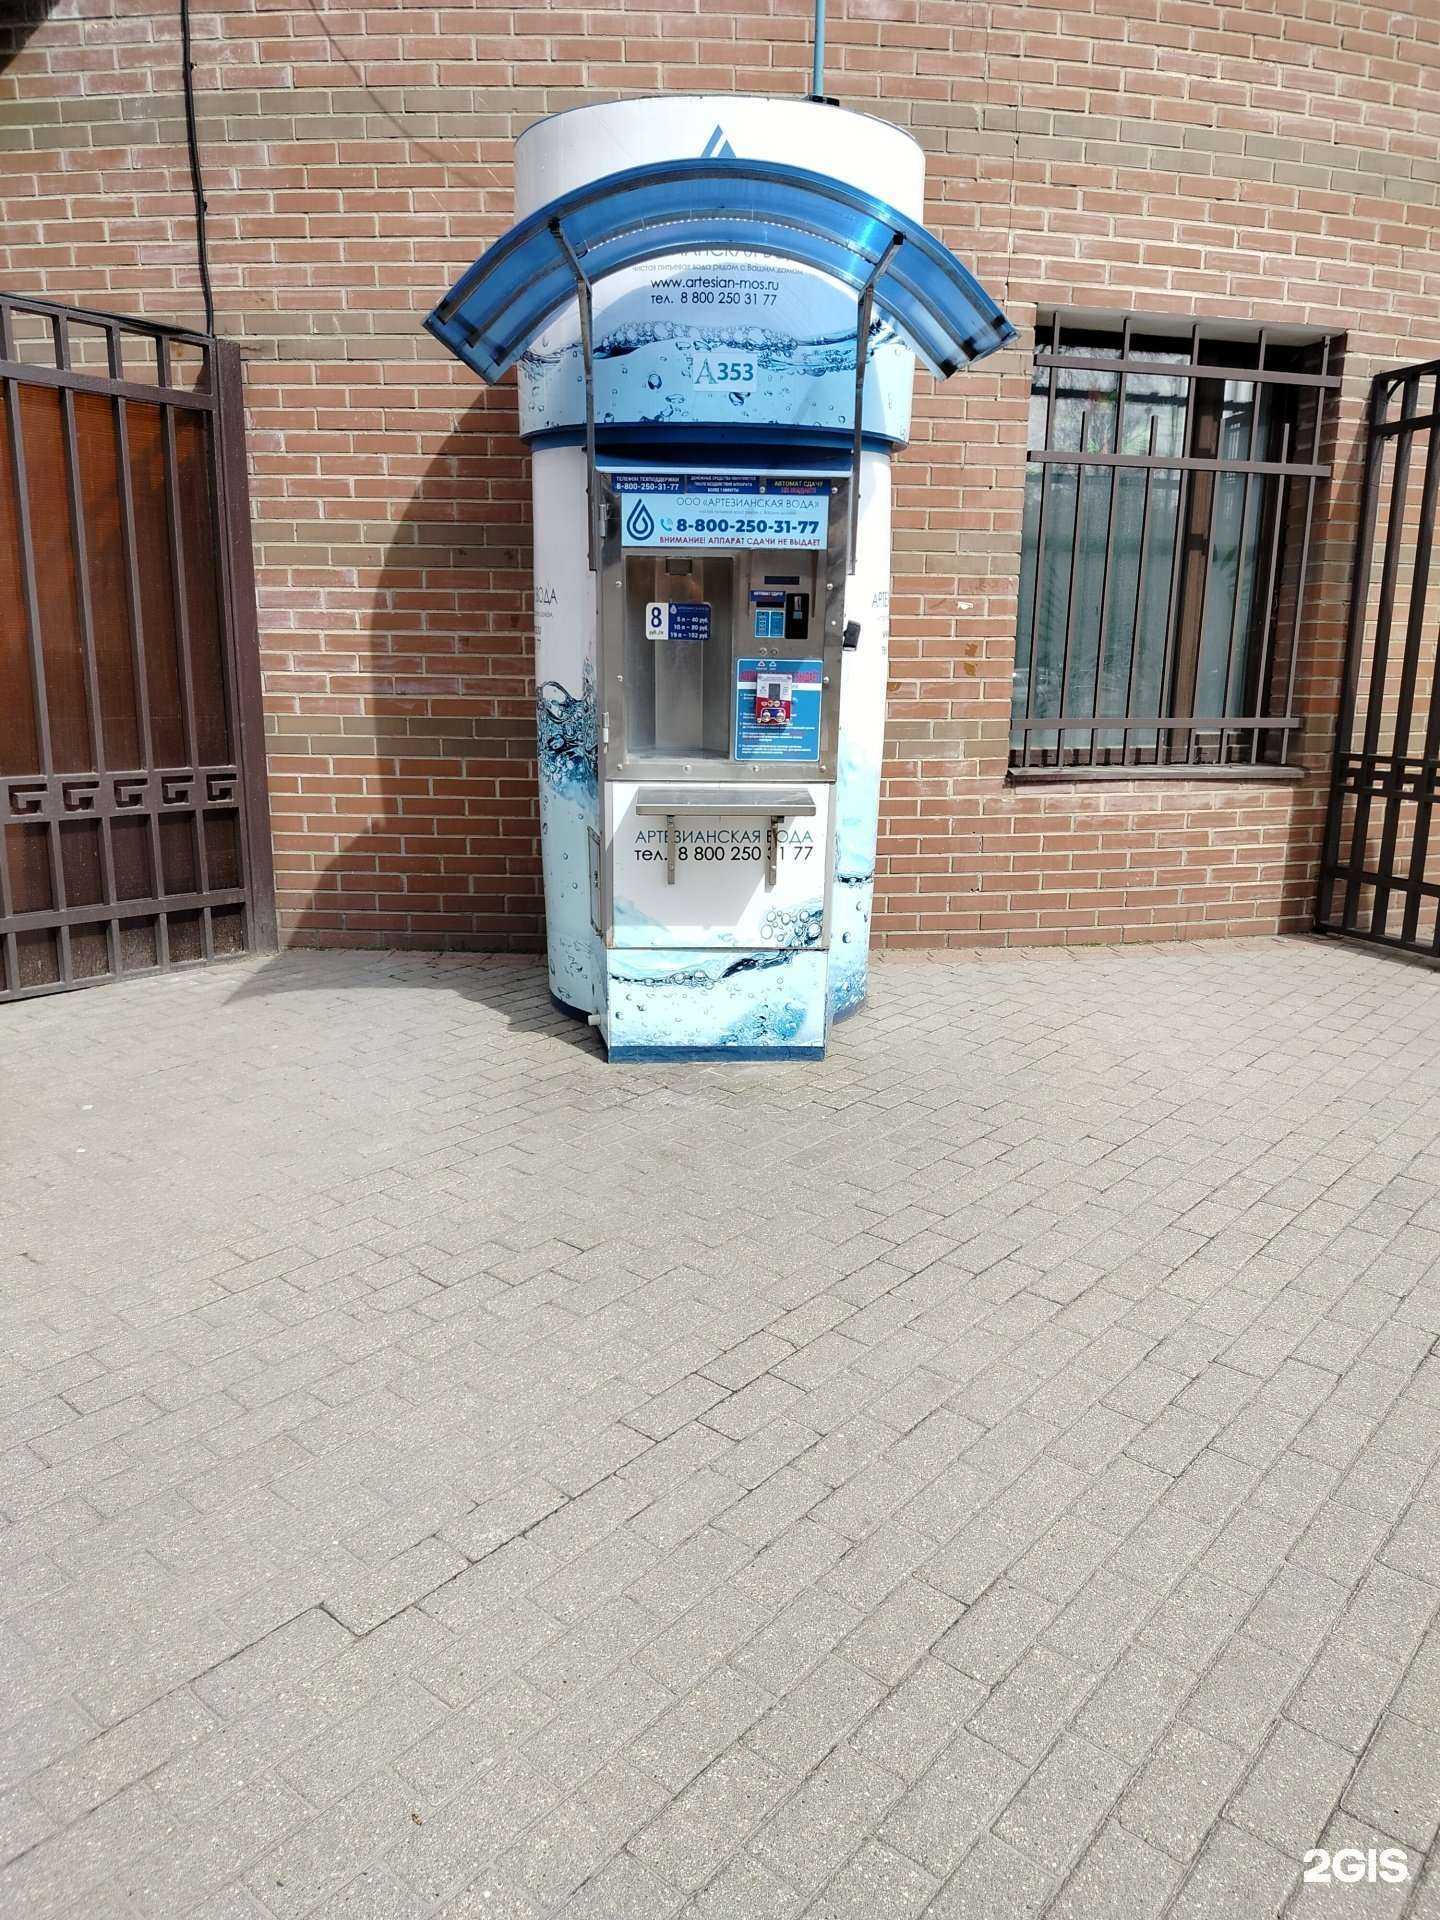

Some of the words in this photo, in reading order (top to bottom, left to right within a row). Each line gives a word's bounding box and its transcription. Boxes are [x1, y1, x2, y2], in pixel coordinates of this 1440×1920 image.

[651, 276, 779, 291] www.artesian-mos.ru
[651, 294, 675, 304] тел.
[681, 292, 688, 304] 8
[692, 292, 714, 304] 800
[718, 292, 741, 305] 250
[744, 293, 757, 305] 31
[762, 294, 777, 306] 77
[616, 482, 680, 491] 8-800-250-31-77
[803, 480, 824, 488] СДАЧУ
[676, 497, 701, 505] ООО
[702, 498, 784, 508] «АРТЕЗИАНСКАЯ
[786, 499, 819, 509] ВОДА»
[676, 518, 820, 534] 8-800-250-31-77
[659, 536, 706, 545] ВНИМАНИЕ!
[708, 537, 745, 545] АППАРАТ
[746, 537, 776, 546] СДАЧИ
[777, 538, 789, 546] НЕ
[790, 538, 821, 547] ВЫДАЕТ
[651, 606, 663, 628] 8
[634, 848, 668, 861] тел.
[678, 846, 688, 861] 8
[694, 846, 725, 861] 800
[730, 846, 762, 861] 250
[794, 846, 813, 861] 77
